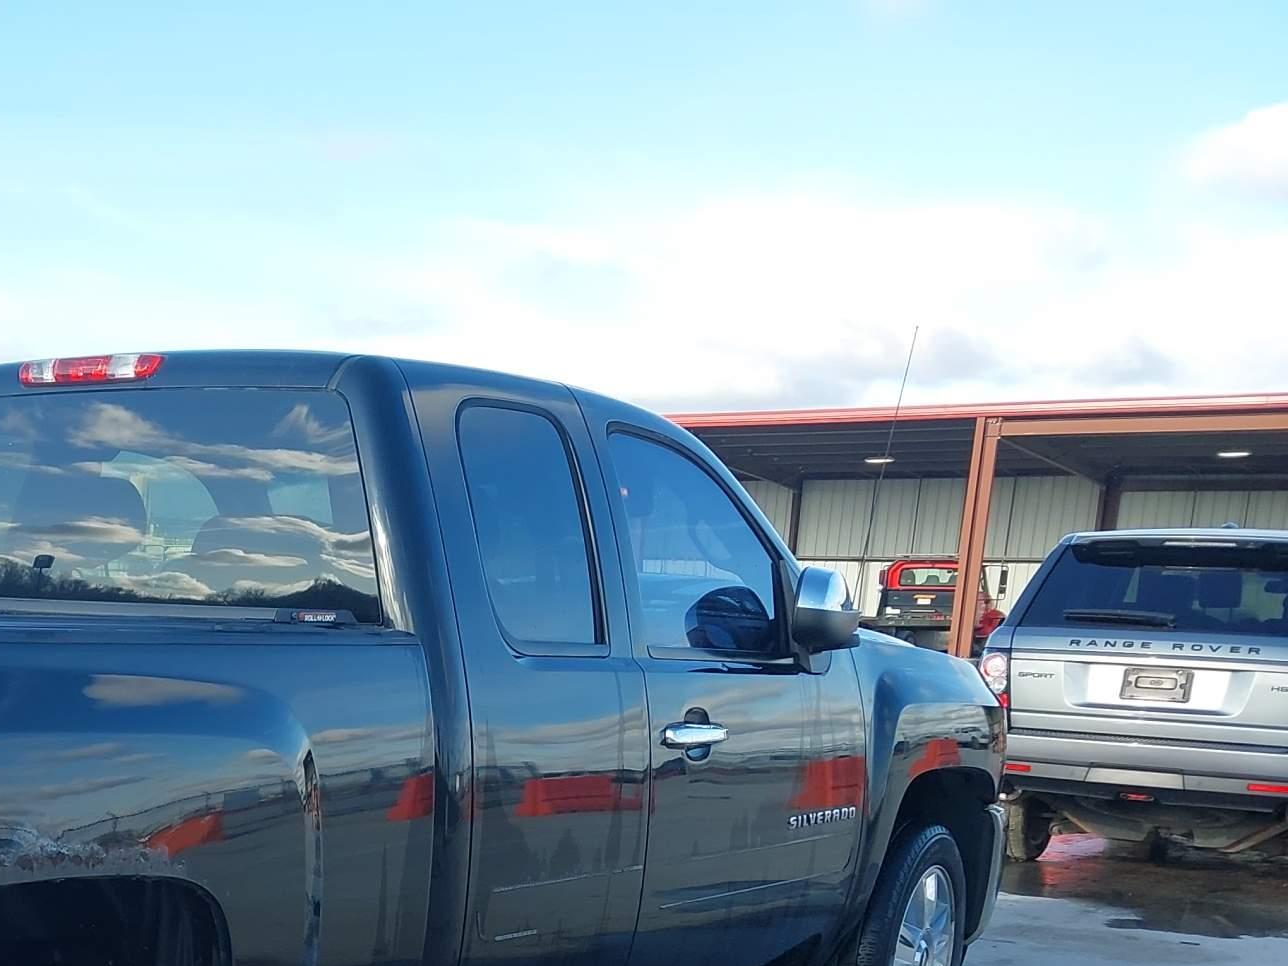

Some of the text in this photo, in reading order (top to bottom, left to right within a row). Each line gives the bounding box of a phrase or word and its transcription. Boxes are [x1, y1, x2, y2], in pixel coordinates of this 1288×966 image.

[1068, 639, 1262, 655] RANGE ROVER
[1018, 671, 1055, 679] SPORT
[789, 806, 856, 830] SILVERADO
